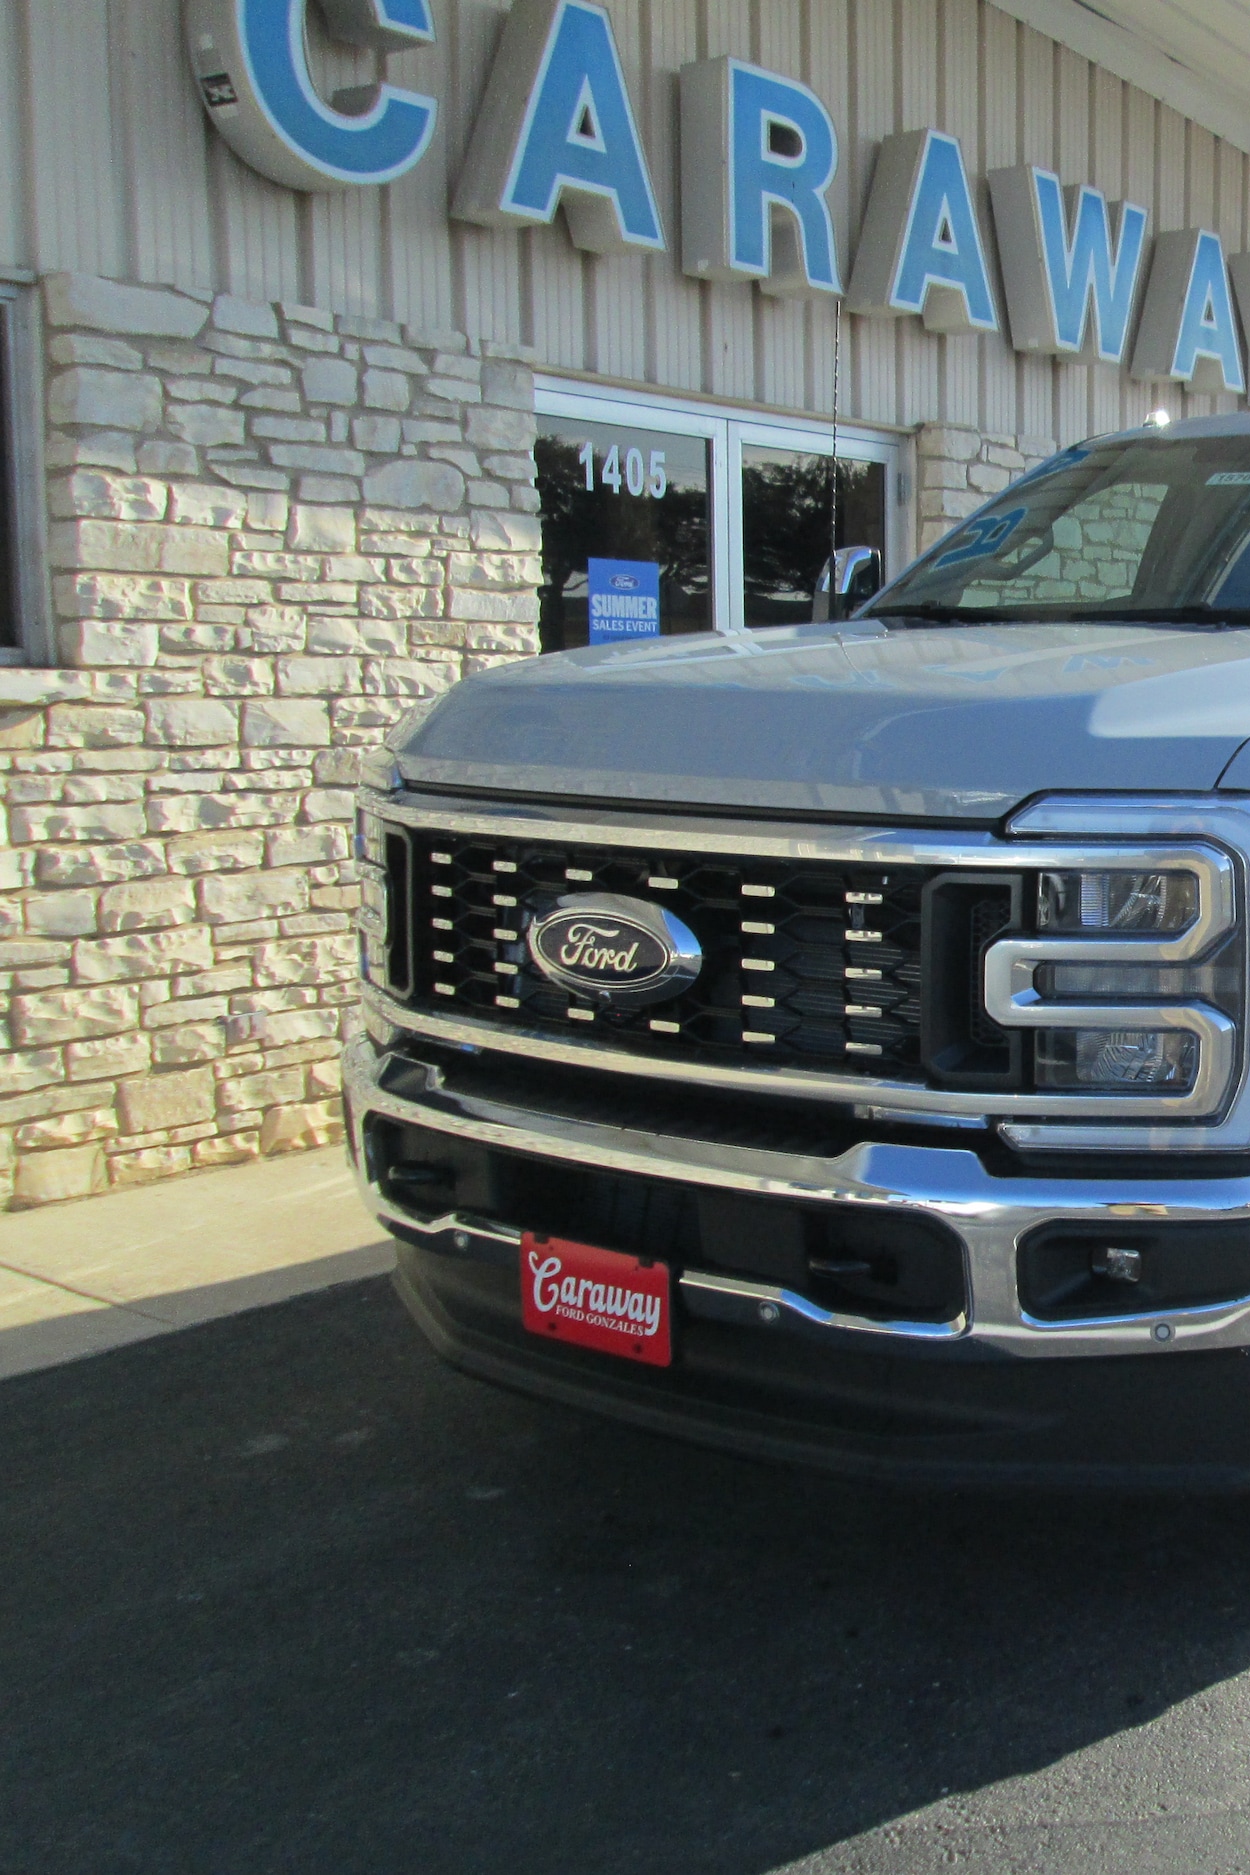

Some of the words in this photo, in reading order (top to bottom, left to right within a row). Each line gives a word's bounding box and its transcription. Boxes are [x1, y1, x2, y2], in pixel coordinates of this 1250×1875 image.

[579, 442, 667, 499] 1405
[614, 575, 635, 588] Ford
[591, 594, 657, 619] SUMMER
[593, 619, 625, 631] SALES
[626, 620, 657, 632] EVENT
[561, 923, 640, 973] Ford
[528, 1251, 661, 1336] Caraway
[556, 1305, 585, 1321] FORD
[586, 1313, 644, 1336] GONZALES
